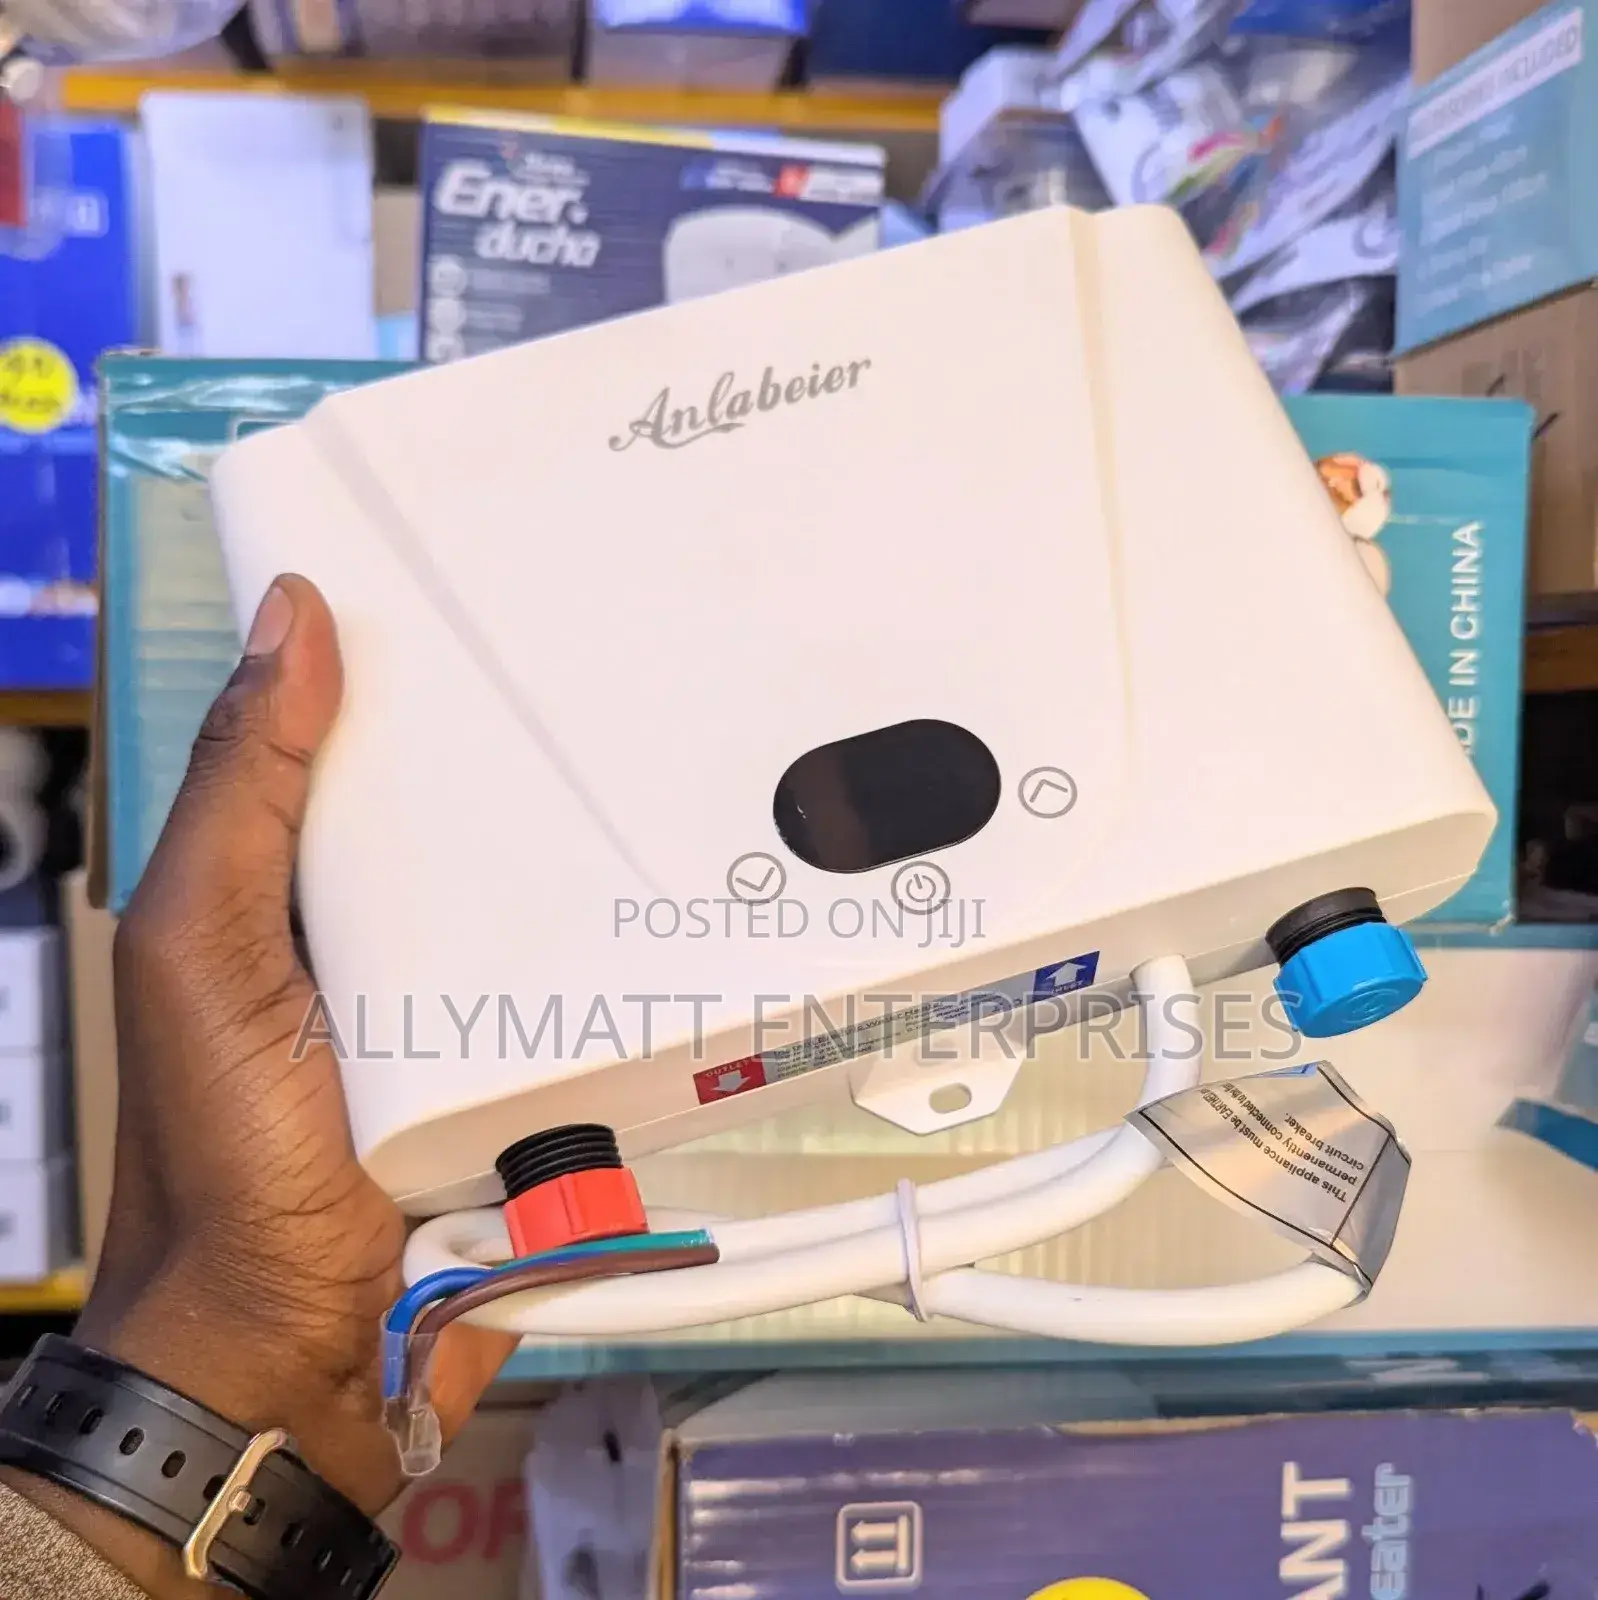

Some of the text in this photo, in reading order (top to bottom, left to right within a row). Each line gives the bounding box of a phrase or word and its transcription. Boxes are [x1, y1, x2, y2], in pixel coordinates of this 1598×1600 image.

[608, 356, 872, 451] Anlabeier
[1450, 520, 1484, 640] CHINA
[1449, 650, 1479, 686] IN
[1230, 1115, 1242, 1129] be
[1238, 1126, 1264, 1149] must
[1243, 1101, 1284, 1141] connected
[1282, 1137, 1358, 1186] permanently
[1284, 1112, 1364, 1171] circuit breaker.
[1263, 1145, 1320, 1185] appliance
[1321, 1180, 1347, 1203] This
